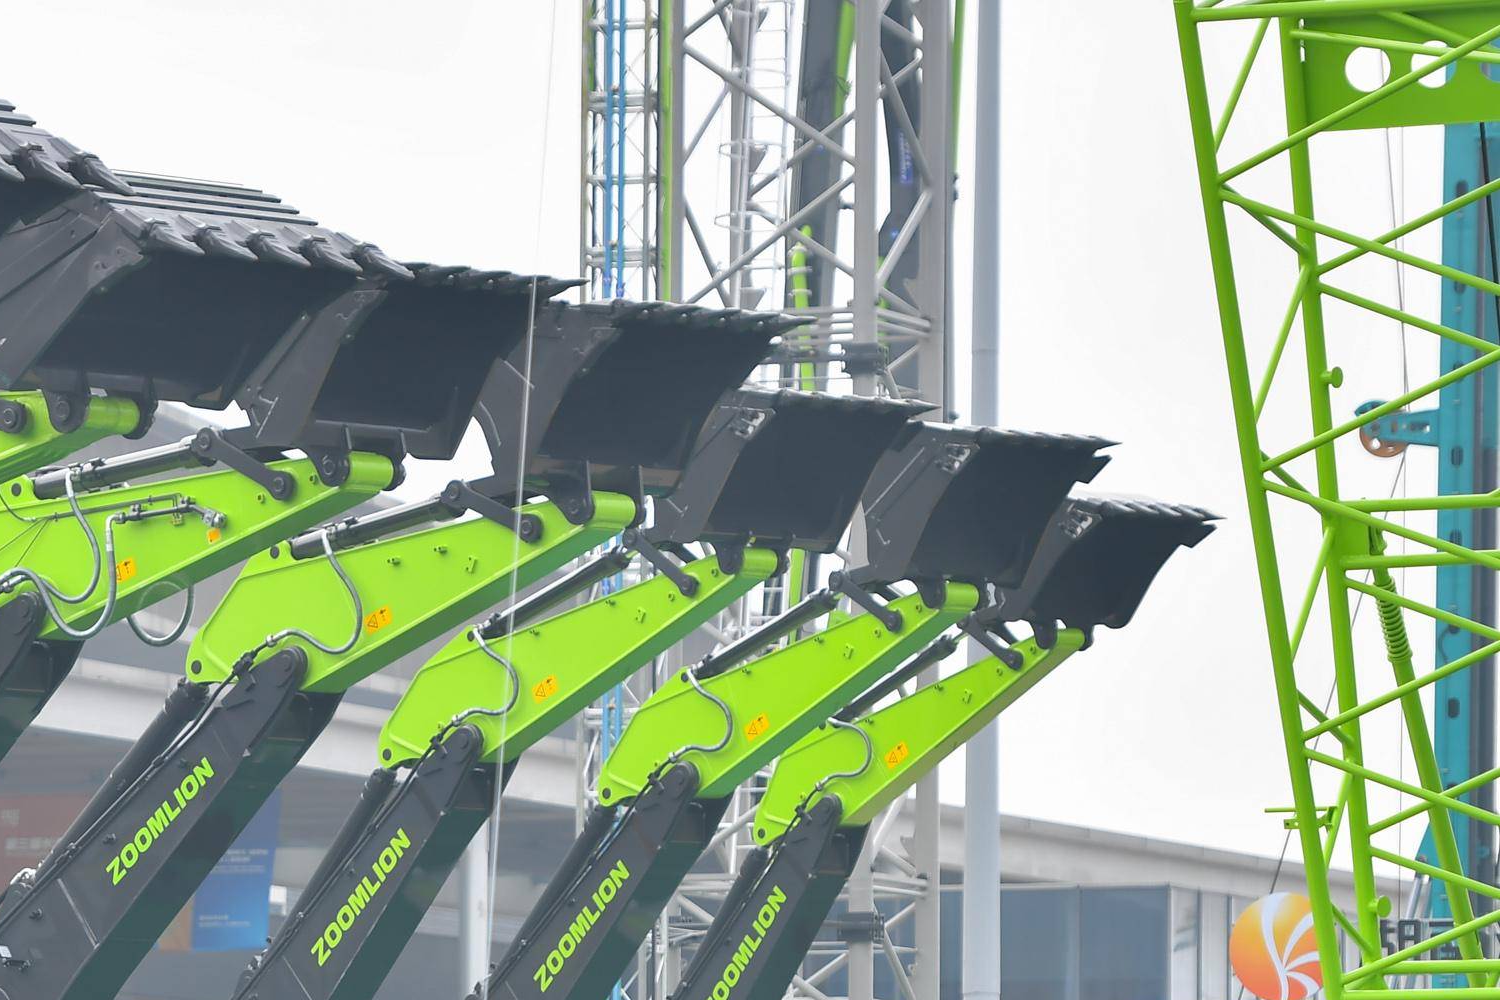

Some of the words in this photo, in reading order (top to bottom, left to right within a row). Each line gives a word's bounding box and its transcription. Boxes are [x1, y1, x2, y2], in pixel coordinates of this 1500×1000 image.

[106, 758, 214, 885] ZOOMLION
[311, 828, 411, 966] ZOOMLION
[534, 861, 630, 992] ZOOMLION
